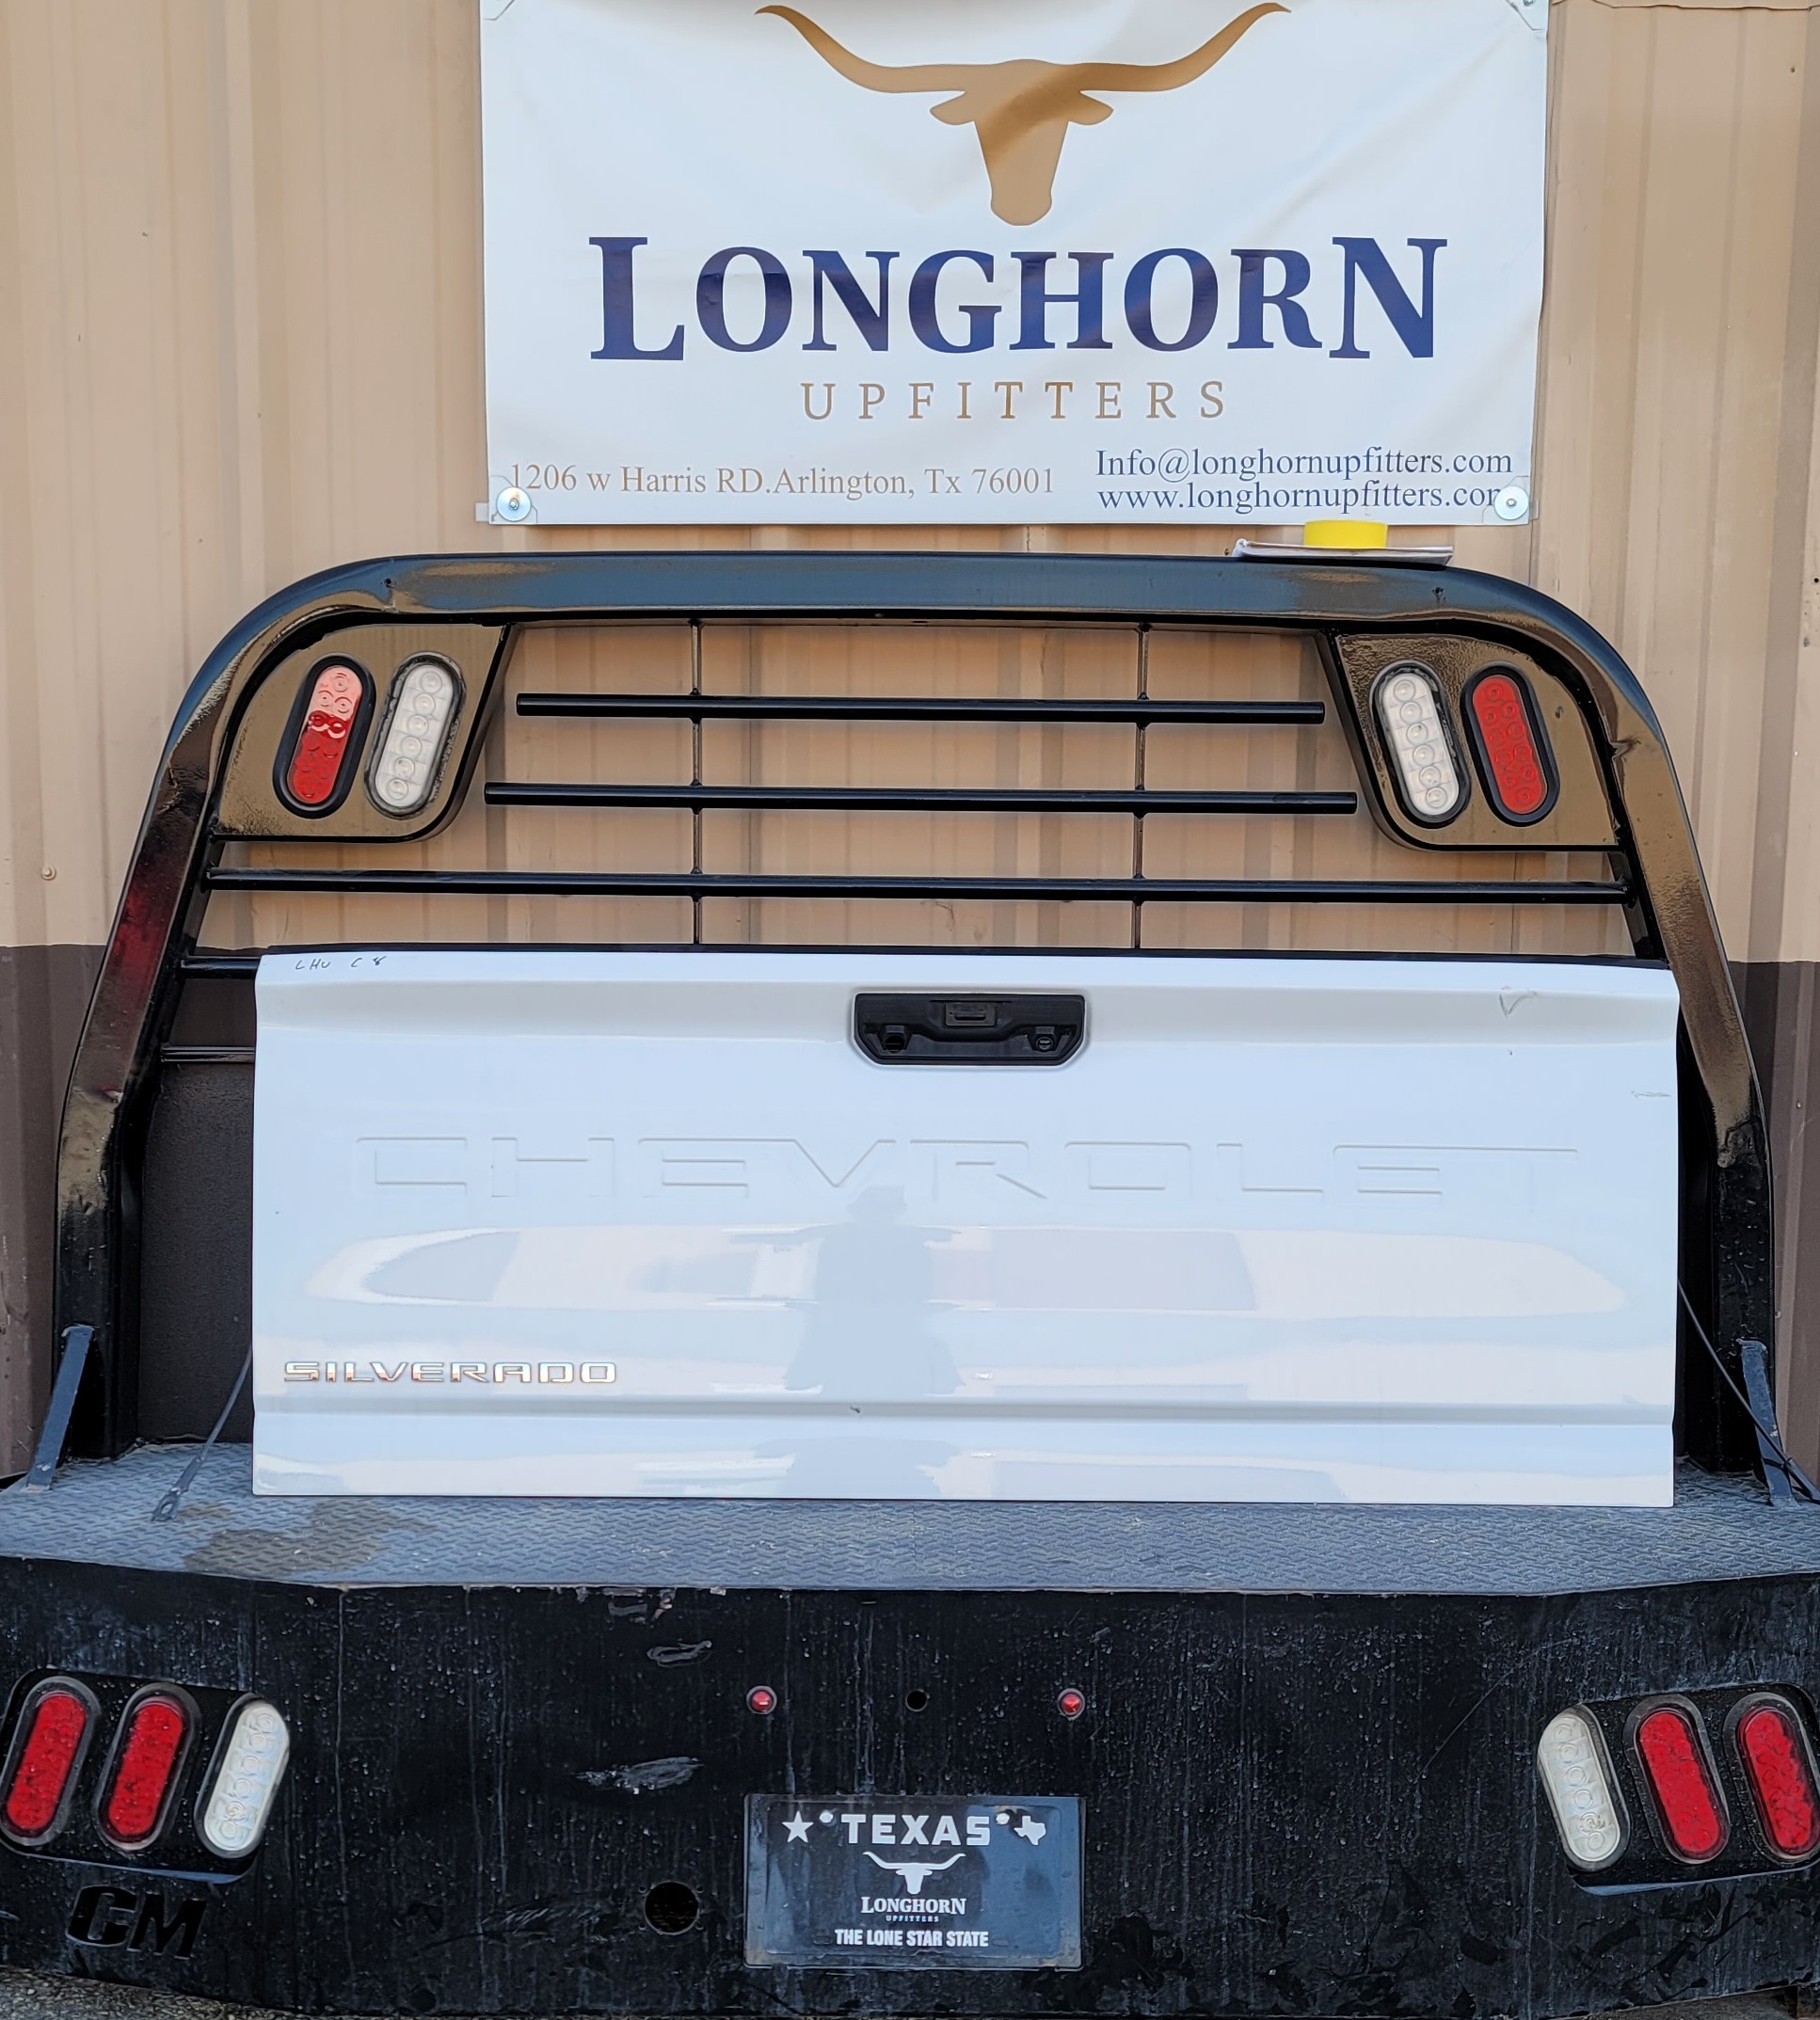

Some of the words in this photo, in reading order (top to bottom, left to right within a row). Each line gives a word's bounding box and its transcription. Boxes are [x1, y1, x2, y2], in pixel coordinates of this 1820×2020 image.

[588, 236, 1448, 361] LONGHORN
[800, 380, 1224, 421] UPFITTERS
[511, 463, 578, 491] 1206
[585, 471, 612, 492] w
[619, 466, 707, 494] Harris
[924, 469, 962, 495] Tx
[971, 468, 1054, 495] 76001
[1095, 446, 1513, 484] Info@longhornupfitters.com
[350, 1137, 1579, 1213] CHEVROLET
[282, 1360, 617, 1384] SILVERADO
[840, 1814, 991, 1846] TEXAS
[65, 1884, 208, 1959] CM
[860, 1896, 967, 1916] LONGHORN
[886, 1915, 940, 1923] UPFITTERS
[835, 1929, 864, 1946] THE
[866, 1929, 903, 1947] LONE
[906, 1930, 943, 1947] STAR
[946, 1931, 989, 1948] STATE
